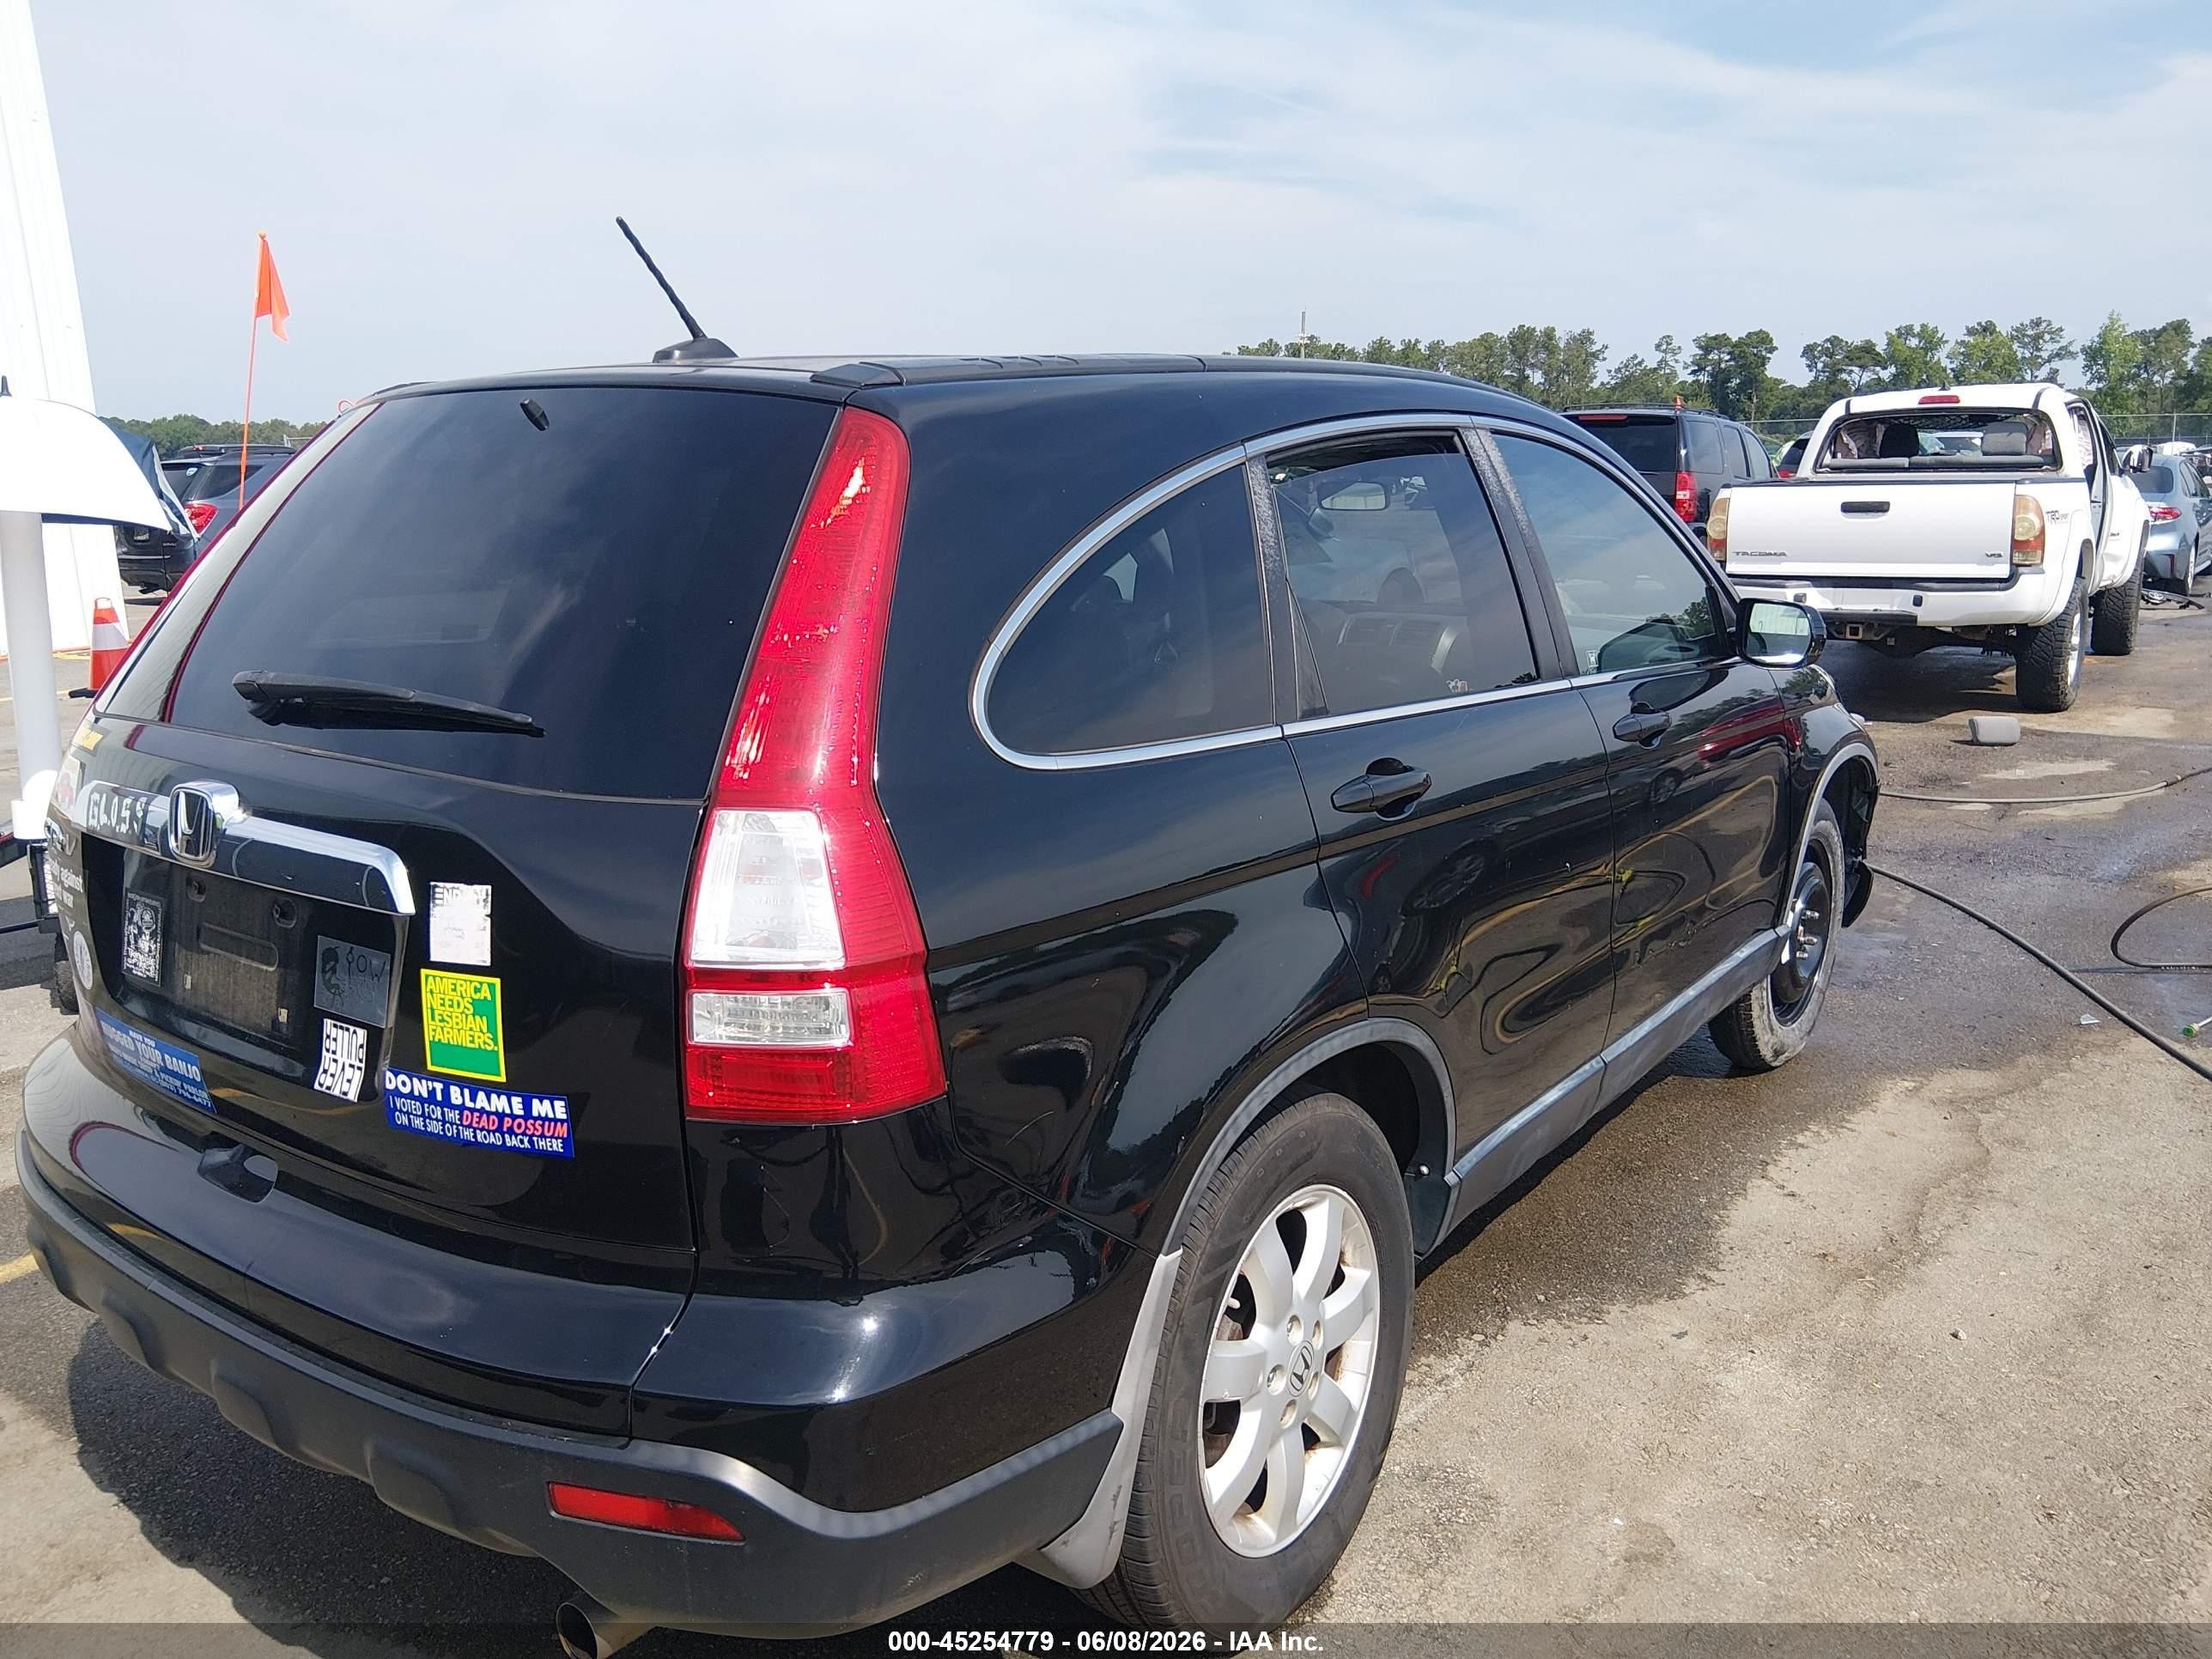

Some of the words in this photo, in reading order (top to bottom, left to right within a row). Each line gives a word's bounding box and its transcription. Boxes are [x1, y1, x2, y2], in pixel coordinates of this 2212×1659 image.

[426, 975, 492, 1001] AMERICA
[427, 993, 474, 1014] NEEDS
[427, 1008, 488, 1033] LESBIAN
[143, 1036, 155, 1048] YOU
[428, 1024, 499, 1051] FARMERS.
[135, 1039, 165, 1066] YOUR
[164, 1053, 202, 1083] BANJO
[386, 1070, 444, 1102] DON'T
[449, 1085, 525, 1115] BLAME
[532, 1098, 568, 1120] ME
[389, 1095, 394, 1109] I
[395, 1097, 422, 1115] VOTED
[423, 1103, 442, 1120] FOR
[443, 1107, 460, 1125] THE
[462, 1109, 499, 1131] DEAD
[503, 1116, 568, 1139] POSSUM
[395, 1112, 410, 1127] ON
[410, 1115, 426, 1131] THE
[426, 1120, 444, 1135] SIDE
[445, 1123, 458, 1138] OF
[459, 1126, 476, 1142] THE
[477, 1130, 502, 1146] ROAD
[505, 1133, 532, 1149] BACK
[532, 1136, 564, 1152] THERE
